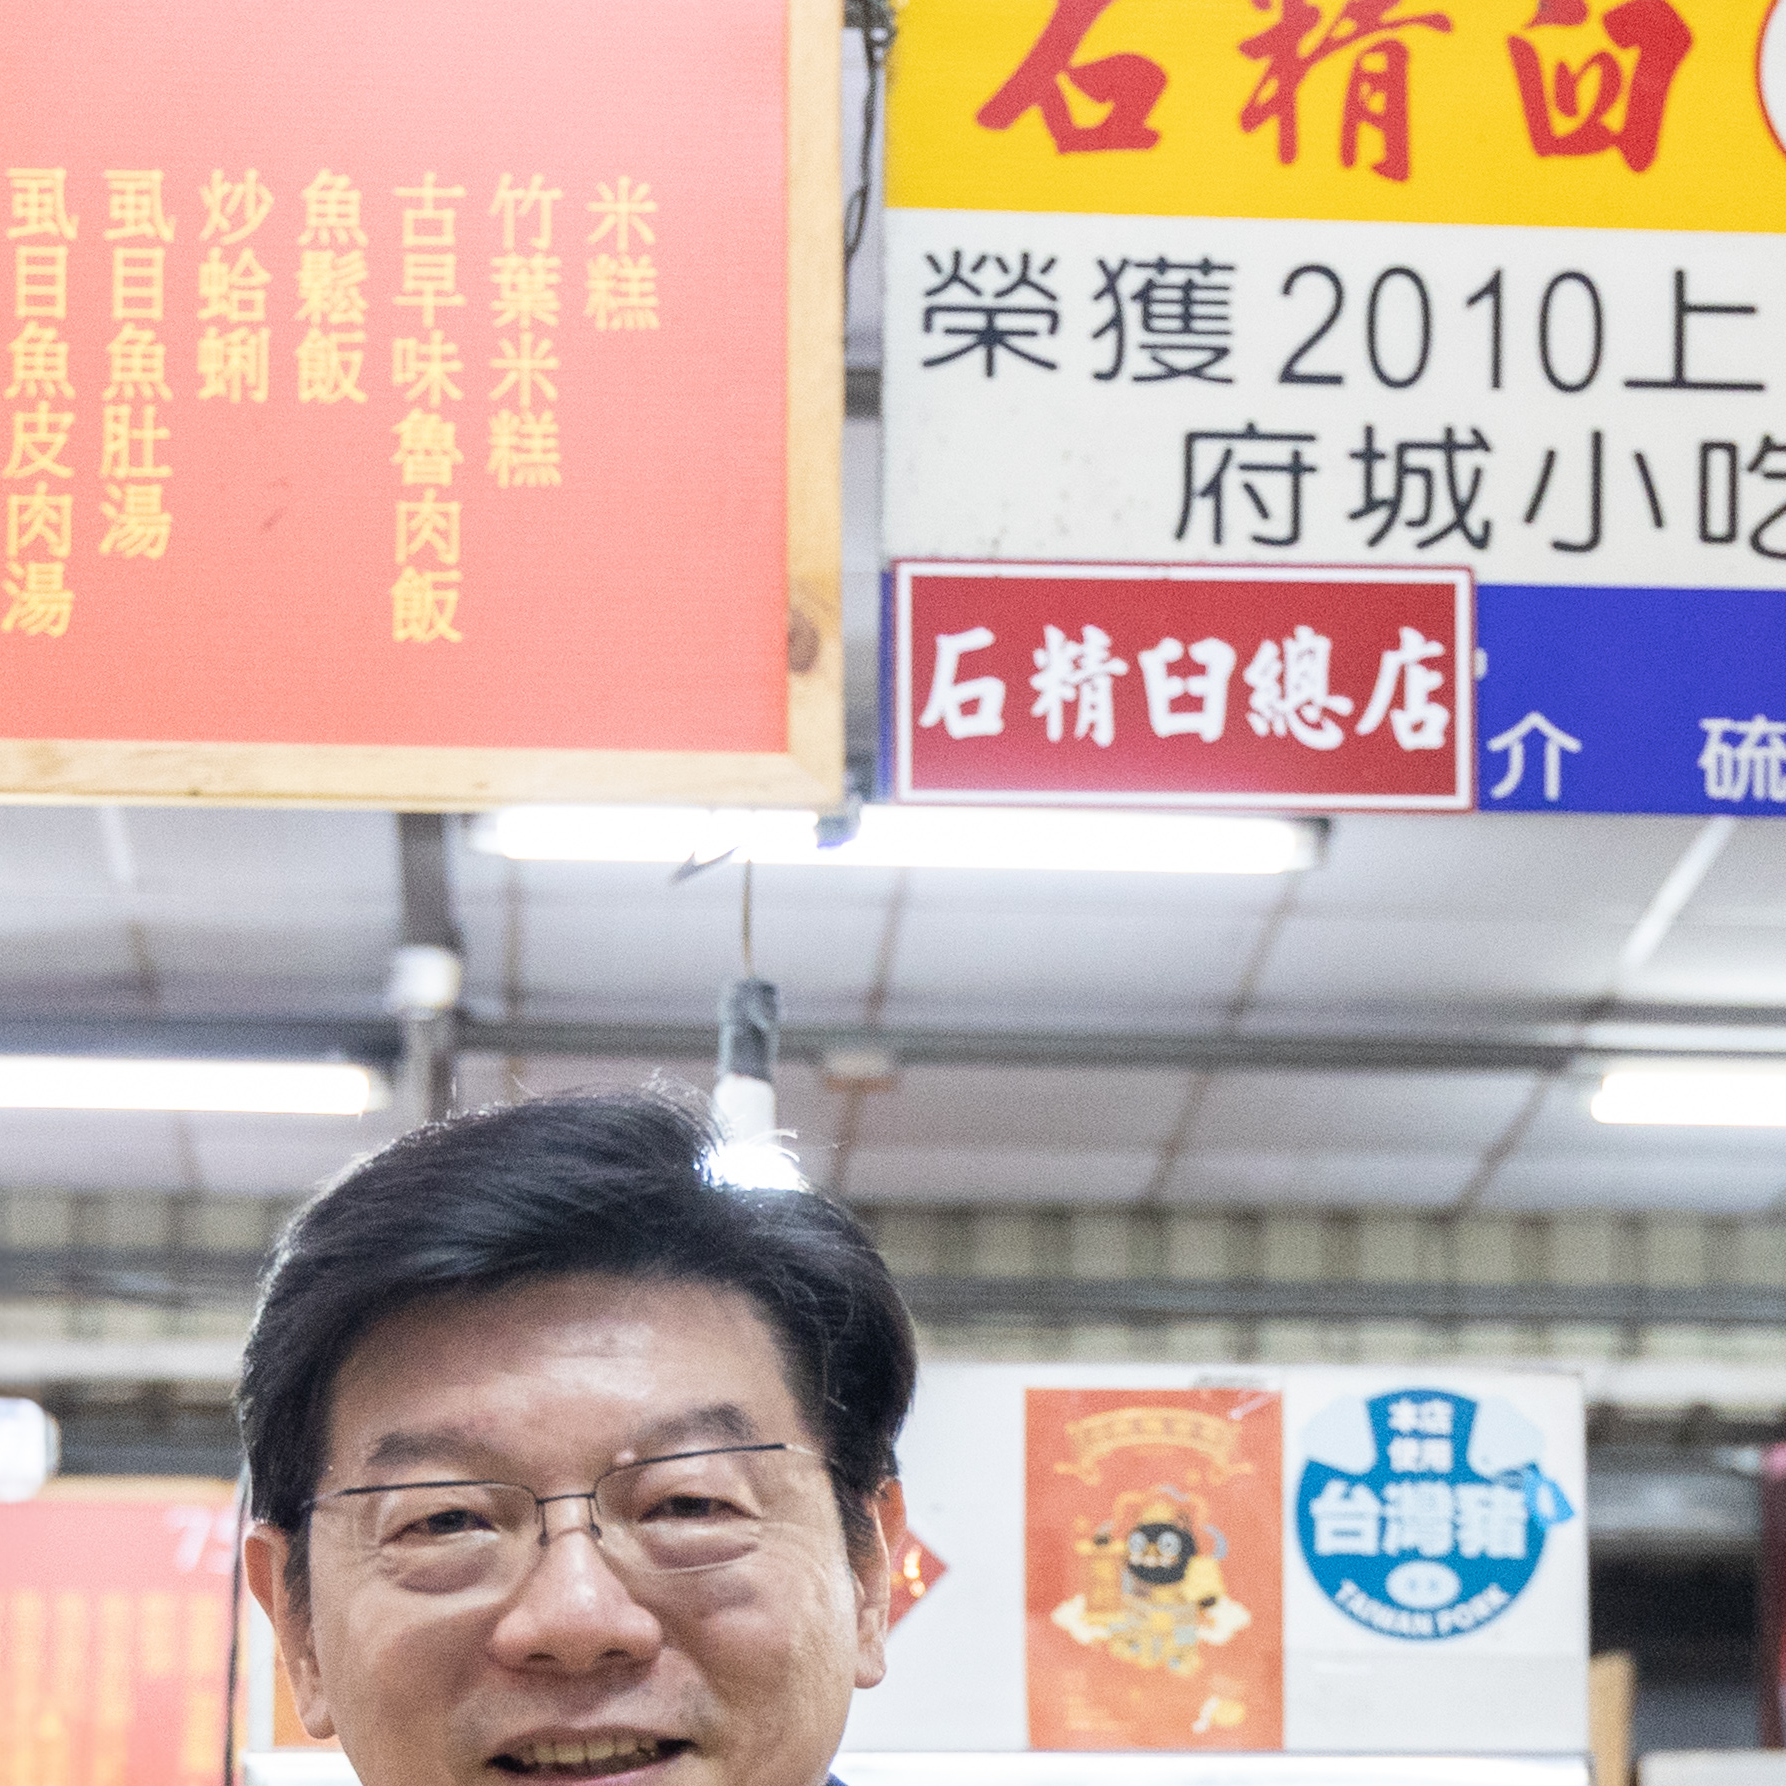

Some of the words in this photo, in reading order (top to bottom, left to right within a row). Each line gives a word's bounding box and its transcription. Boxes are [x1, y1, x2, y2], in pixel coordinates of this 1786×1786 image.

[99, 169, 175, 560] 虱目魚肚湯
[197, 168, 274, 403] 炒蛤蜊
[296, 169, 368, 403] 魚鬆飯
[488, 173, 562, 488] 竹葉米糕
[585, 176, 660, 331] 米糕
[1, 167, 79, 638] 虱目魚皮肉湯
[390, 172, 466, 643] 古早味魯肉飯
[919, 625, 1451, 750] 石精臼總店
[1310, 1480, 1528, 1560] 台灣豬
